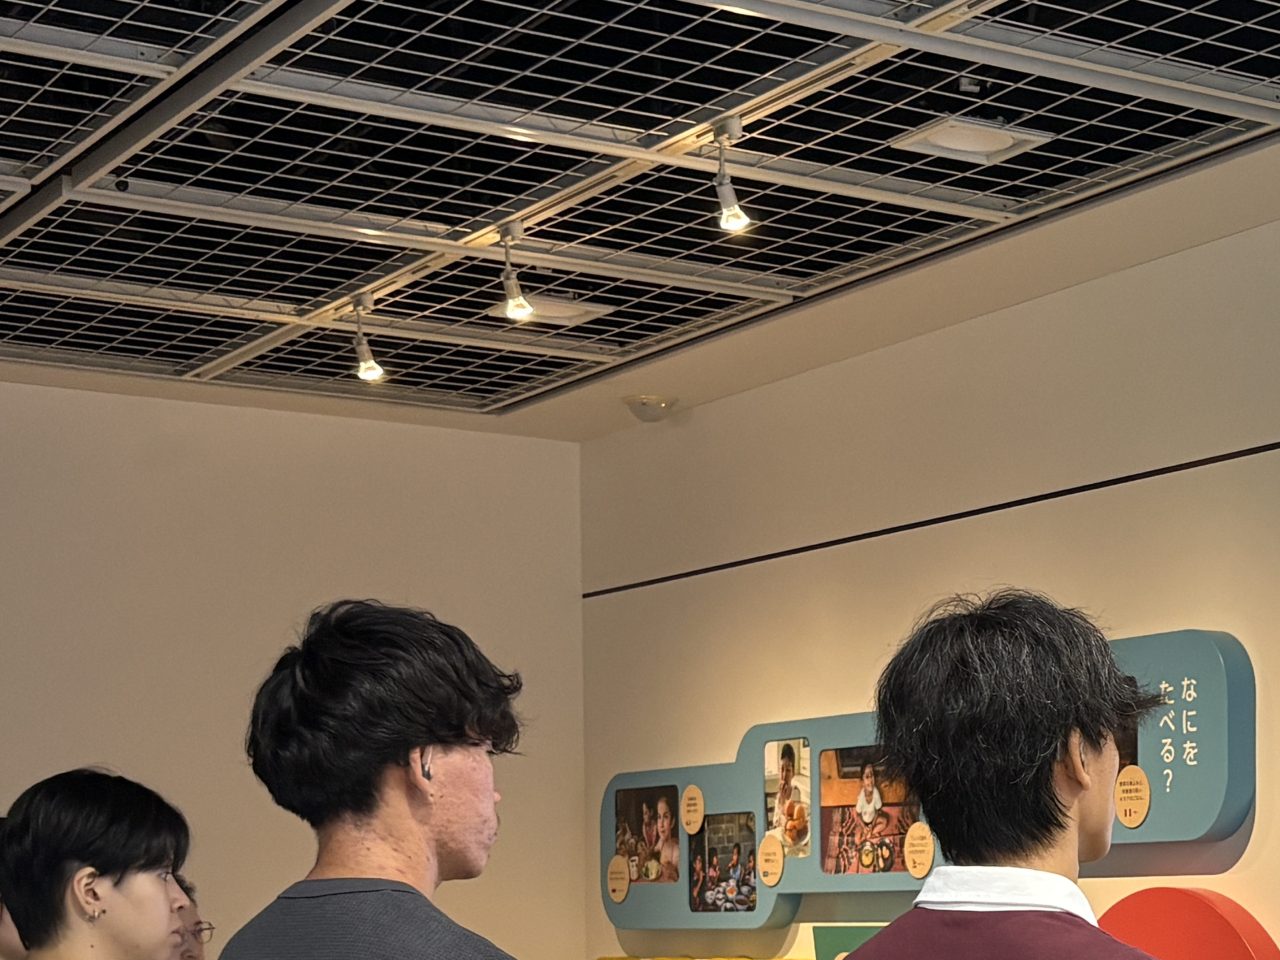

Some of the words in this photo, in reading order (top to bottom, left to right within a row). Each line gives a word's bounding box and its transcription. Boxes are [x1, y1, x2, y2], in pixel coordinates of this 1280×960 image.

[1159, 680, 1175, 793] たべる？
[1181, 676, 1198, 766] なにを
